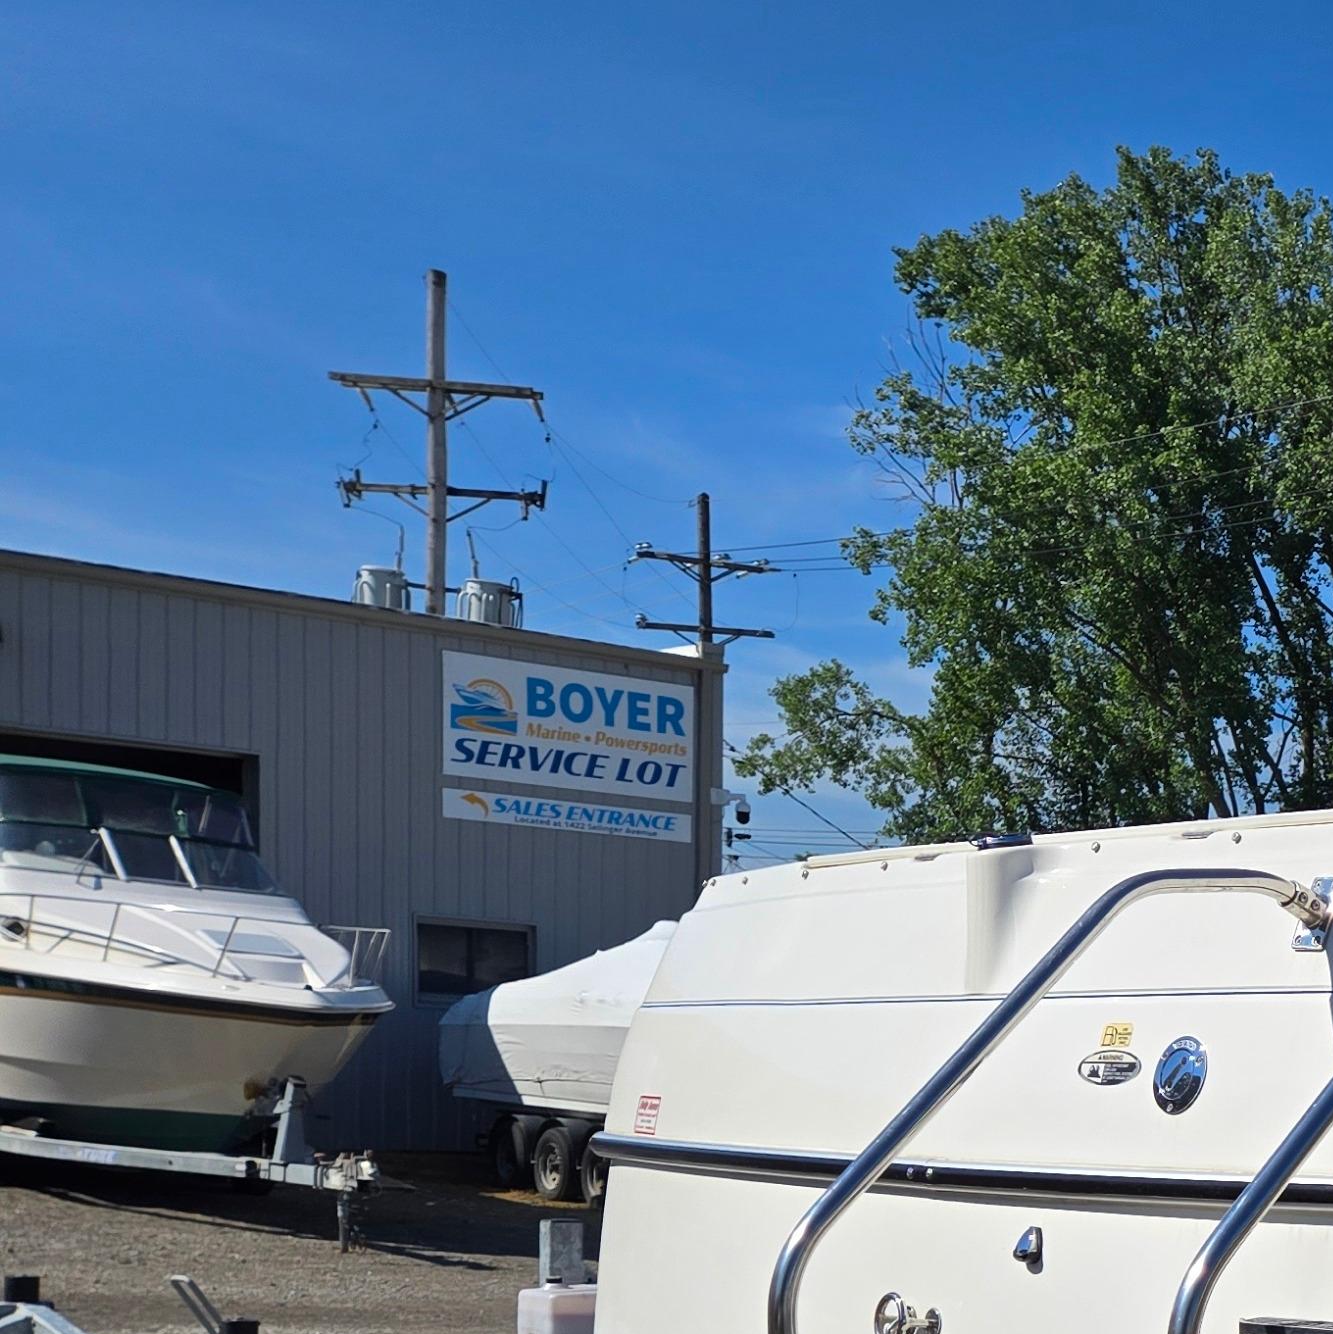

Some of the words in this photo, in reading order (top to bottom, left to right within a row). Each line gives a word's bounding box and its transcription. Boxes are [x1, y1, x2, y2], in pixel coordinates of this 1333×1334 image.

[526, 676, 686, 737] BOYER
[526, 722, 581, 744] Marine
[595, 731, 688, 757] Powersports
[450, 737, 610, 780] SERVICE
[615, 757, 687, 787] LOT
[492, 797, 562, 819] SALES
[566, 806, 678, 832] ENTRANCE
[514, 815, 551, 827] Located
